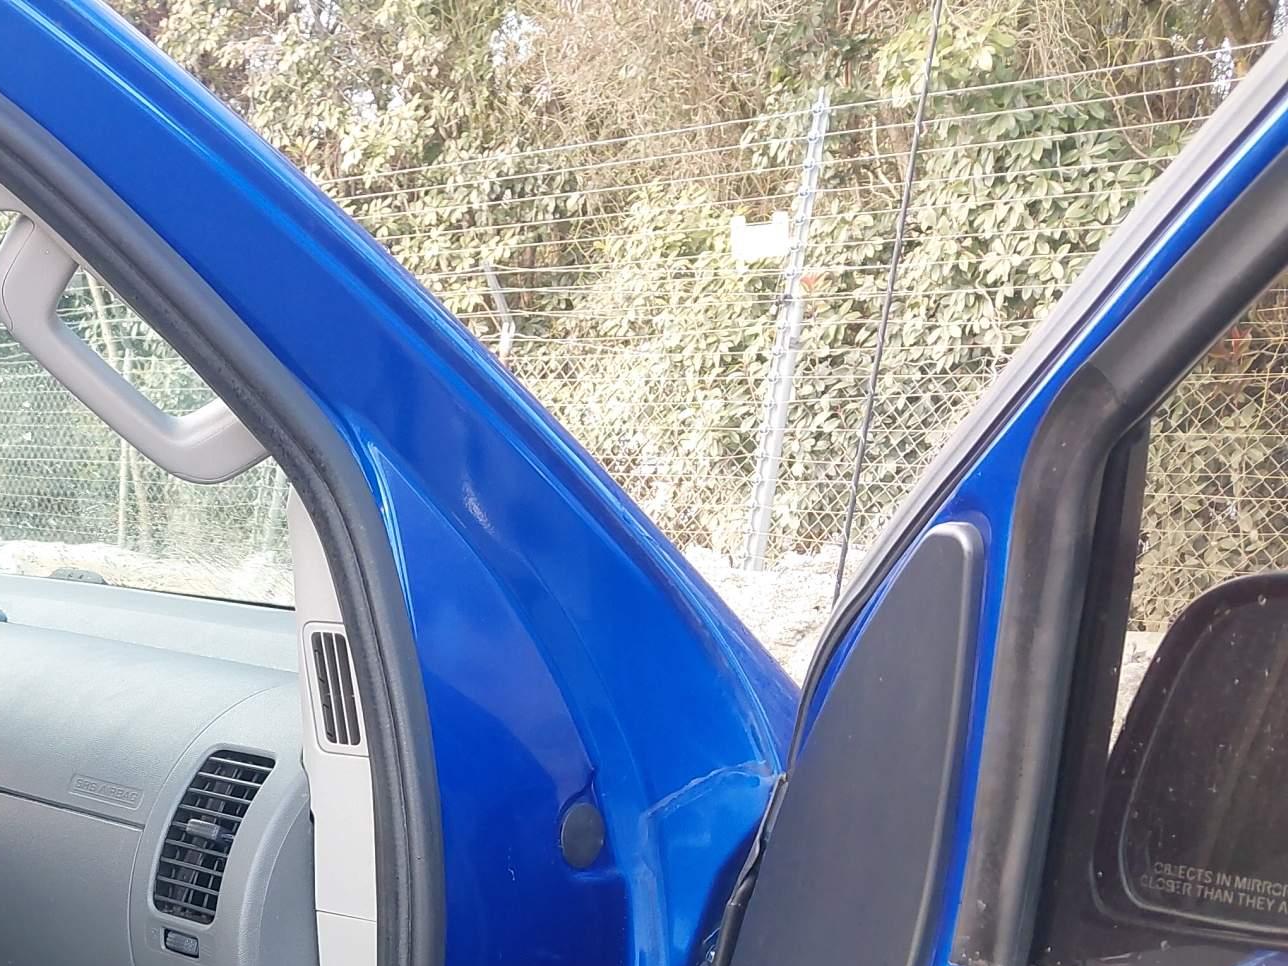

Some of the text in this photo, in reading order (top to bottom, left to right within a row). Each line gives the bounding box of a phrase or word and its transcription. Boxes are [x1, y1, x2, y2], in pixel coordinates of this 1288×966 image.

[99, 785, 139, 803] AIRBAG
[1215, 872, 1232, 887] IN
[1140, 874, 1192, 896] CLOSER
[1196, 885, 1233, 904] THAN
[1238, 893, 1275, 911] THEY
